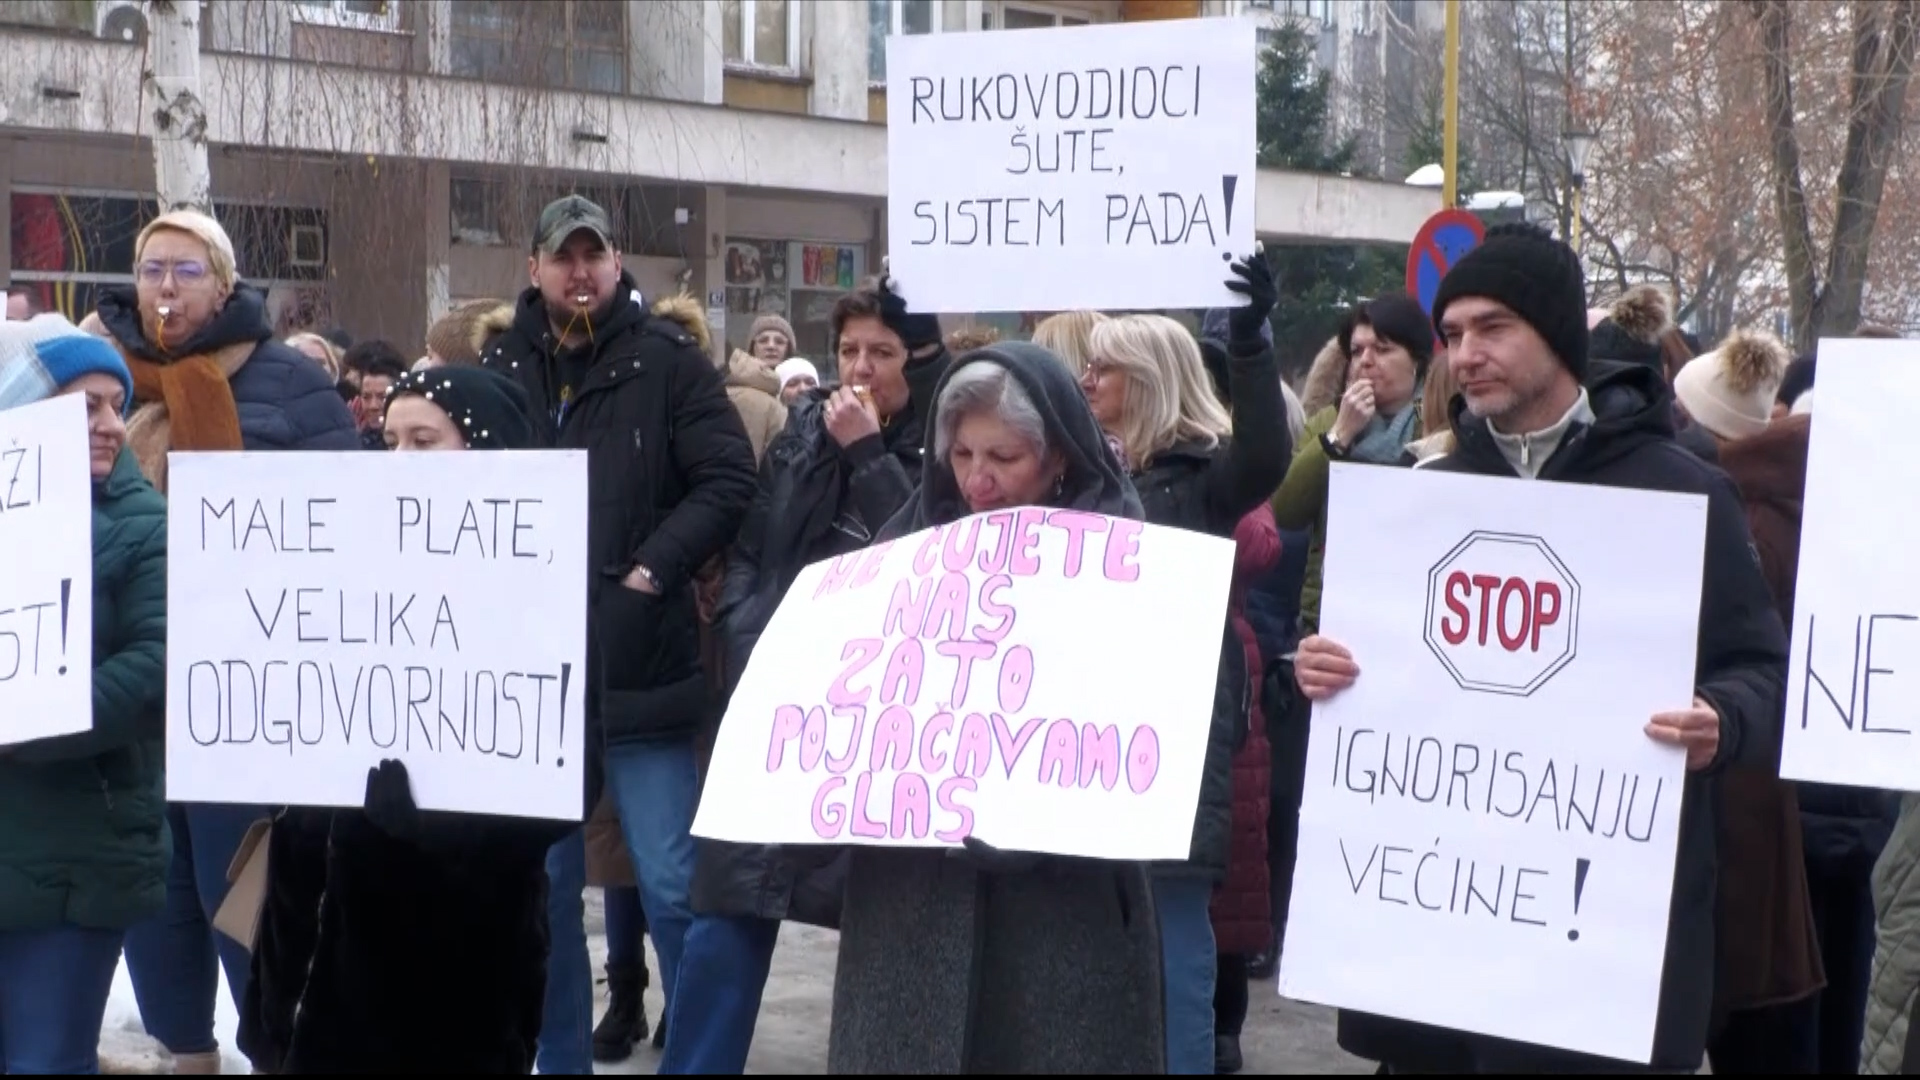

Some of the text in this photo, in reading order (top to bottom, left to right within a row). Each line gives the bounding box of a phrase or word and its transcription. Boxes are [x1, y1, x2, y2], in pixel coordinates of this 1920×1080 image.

[909, 64, 1201, 124] RUKOVODIOCI
[1005, 125, 1125, 176] ŠUTE,
[910, 174, 1239, 262] SISTEM PADA!
[0, 437, 42, 512] ŽI
[201, 496, 554, 565] MALE PLATE,
[245, 587, 460, 652] VELIKA
[883, 569, 1017, 644] NAS
[1440, 569, 1562, 653] STOP
[826, 636, 1035, 714] ZATO
[187, 660, 572, 768] ODGOVORNOST!
[765, 700, 1161, 795] POJAČAVAMO
[810, 770, 979, 843] GLAS
[1331, 725, 1664, 844] IGNORISANJU
